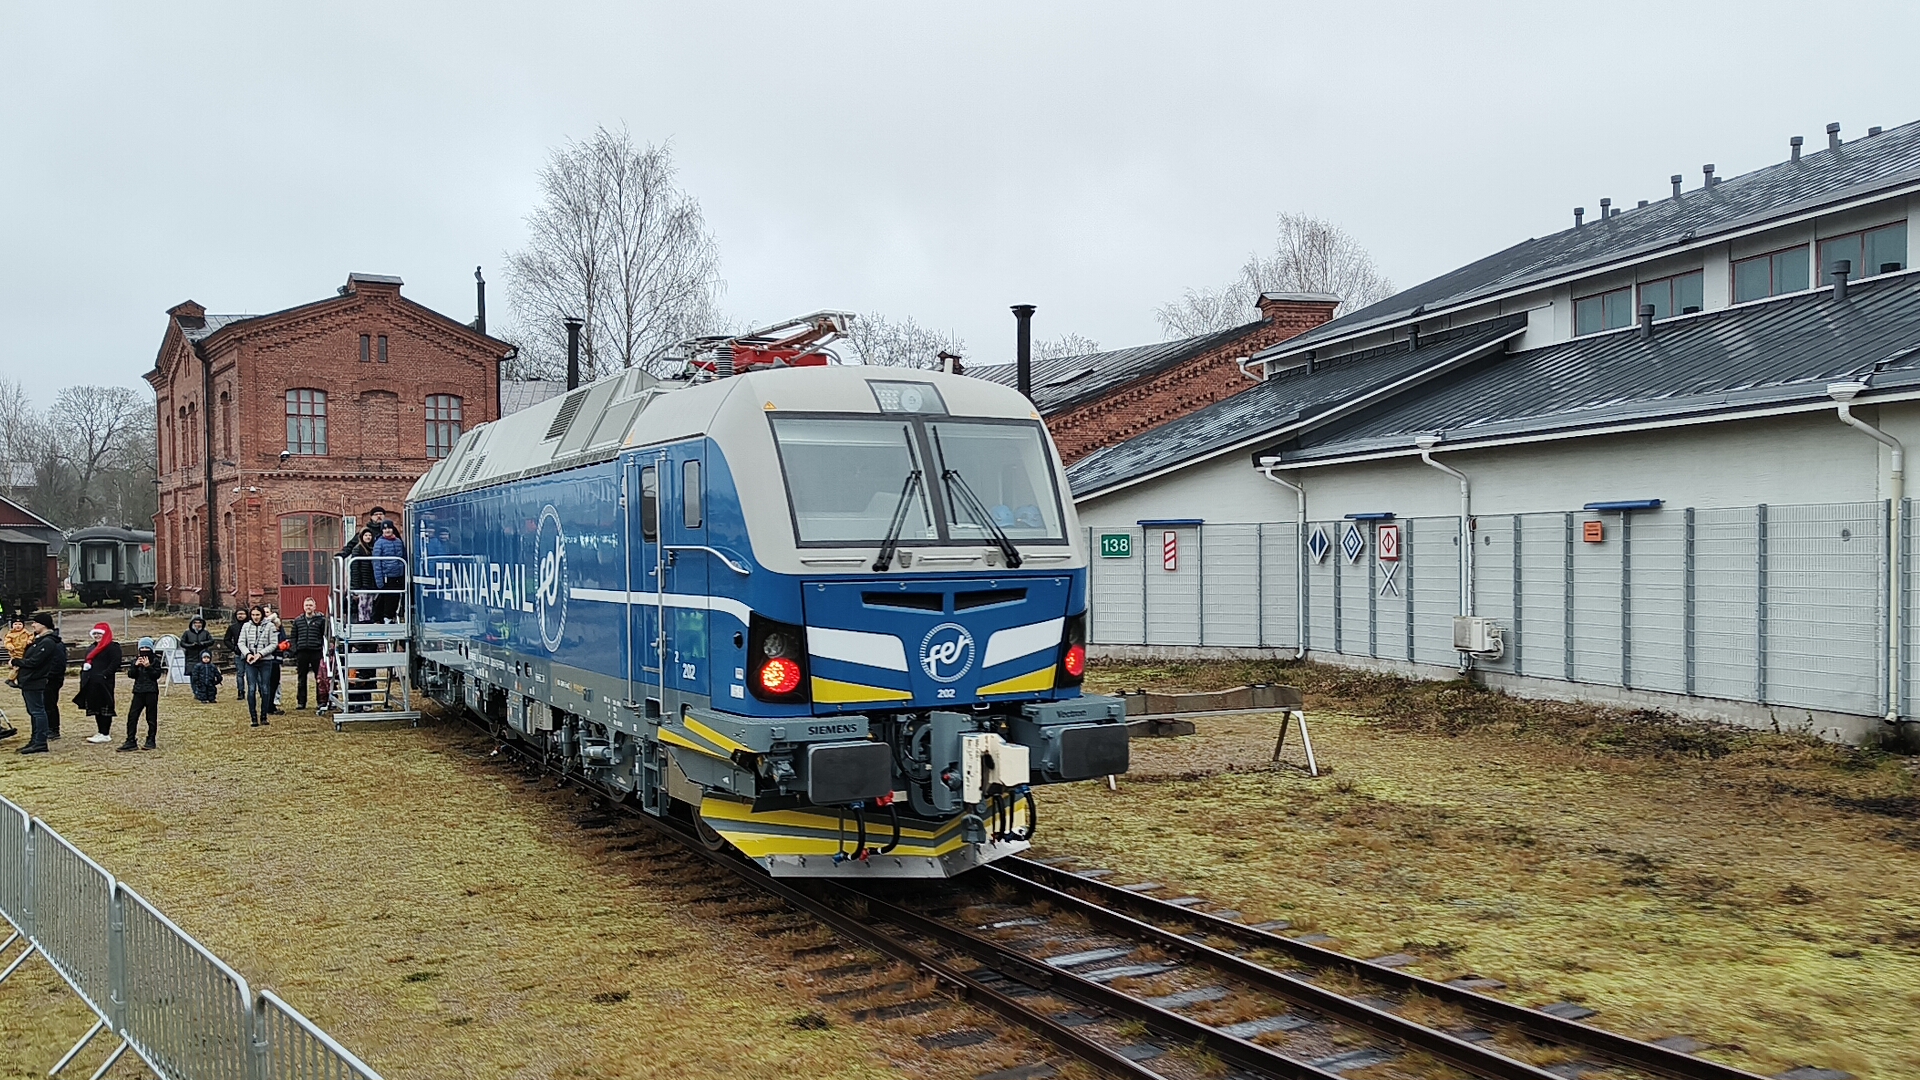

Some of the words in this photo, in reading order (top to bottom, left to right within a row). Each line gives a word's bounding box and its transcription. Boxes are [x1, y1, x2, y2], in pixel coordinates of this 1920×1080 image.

[1103, 538, 1129, 553] 138
[435, 561, 534, 613] FENNIARAIL
[924, 634, 971, 676] fer
[682, 663, 697, 680] 202
[936, 688, 956, 699] 202
[808, 723, 858, 736] SIEMENS
